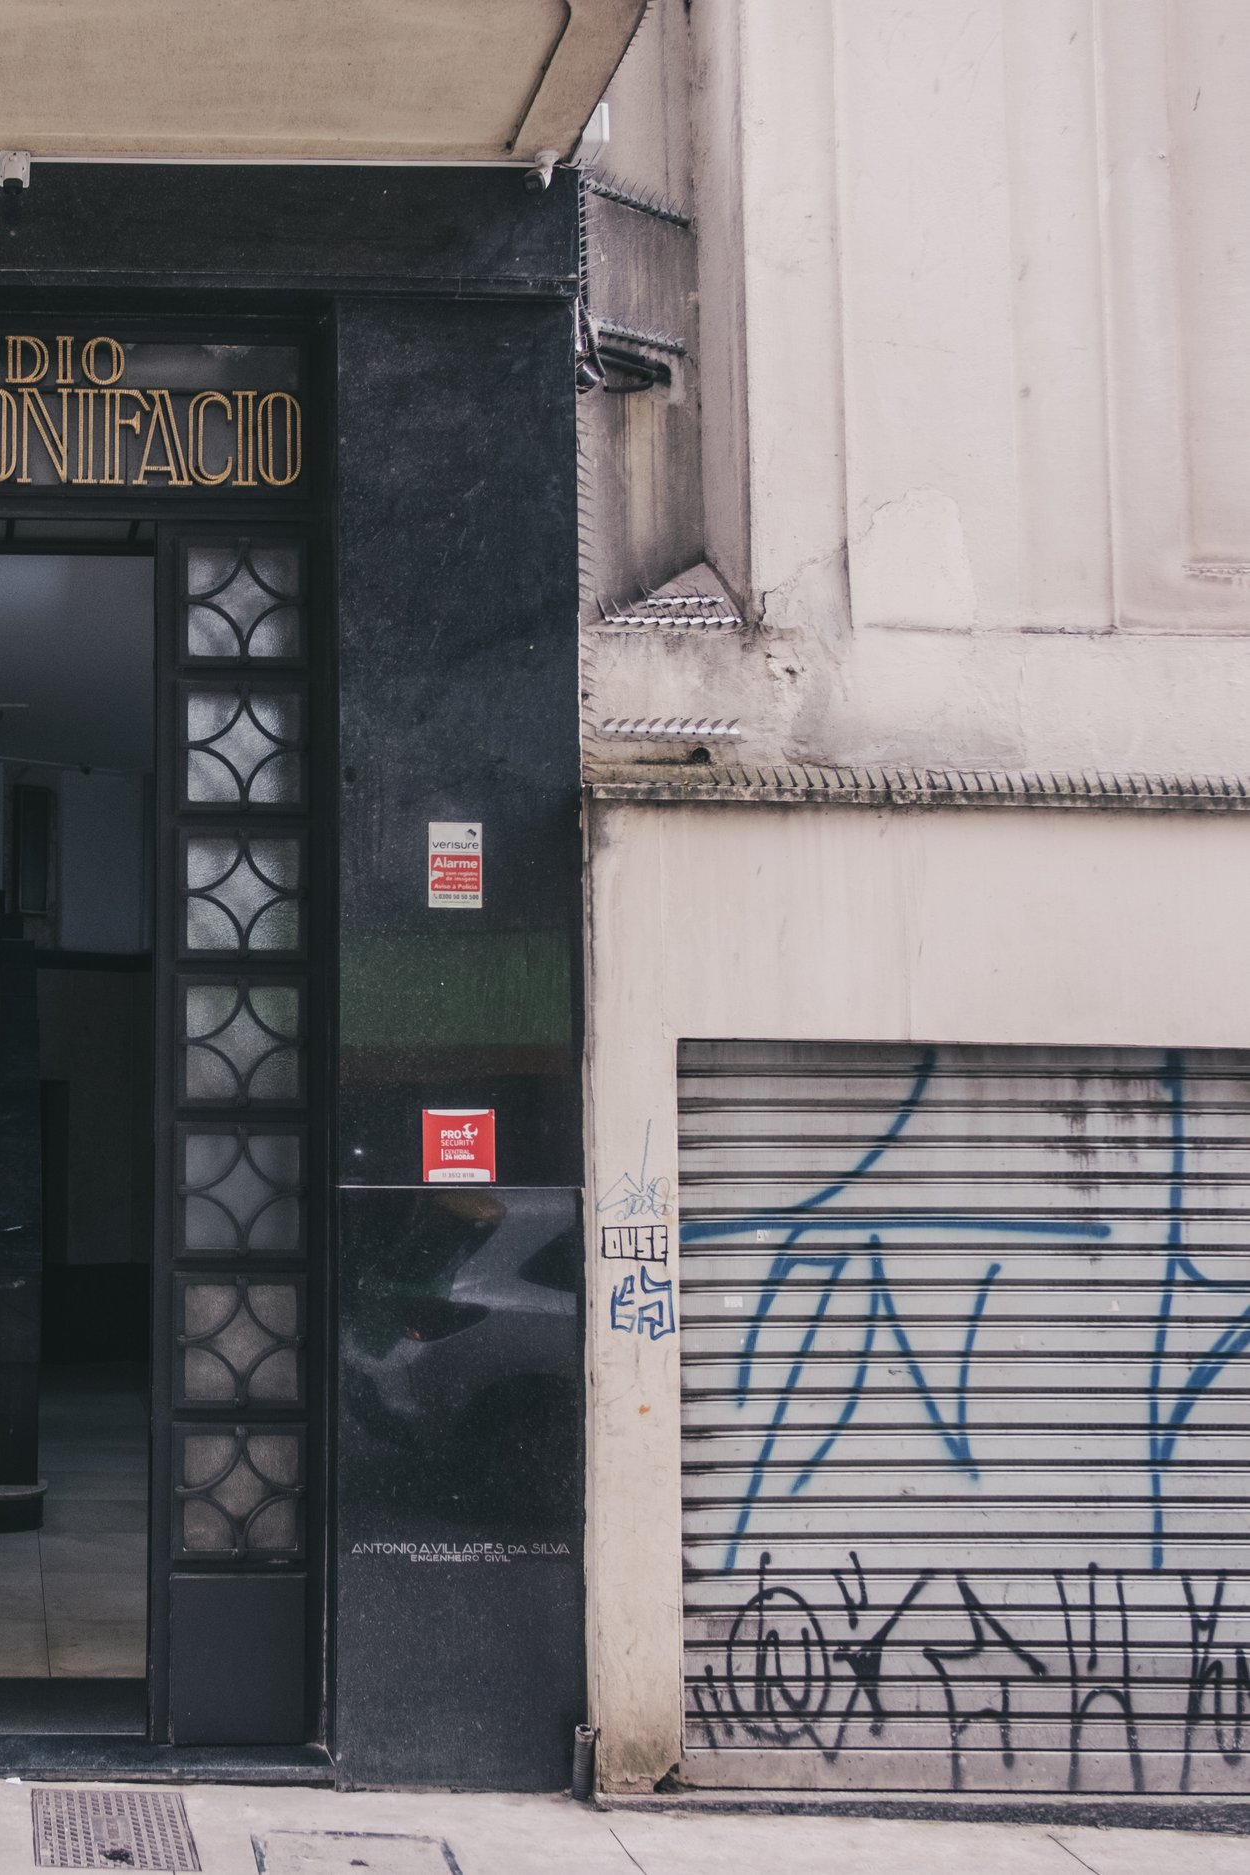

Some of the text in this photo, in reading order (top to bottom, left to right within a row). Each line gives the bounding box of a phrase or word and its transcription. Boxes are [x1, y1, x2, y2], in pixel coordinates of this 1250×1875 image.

[432, 841, 479, 850] verisure
[433, 857, 478, 869] Alarme
[441, 1130, 461, 1139] PRO
[440, 1139, 475, 1147] SECURITY
[351, 1542, 417, 1554] ANTONIO
[530, 1543, 571, 1555] SILVA
[410, 1554, 511, 1562] ENGENHEIRO CIVIL
